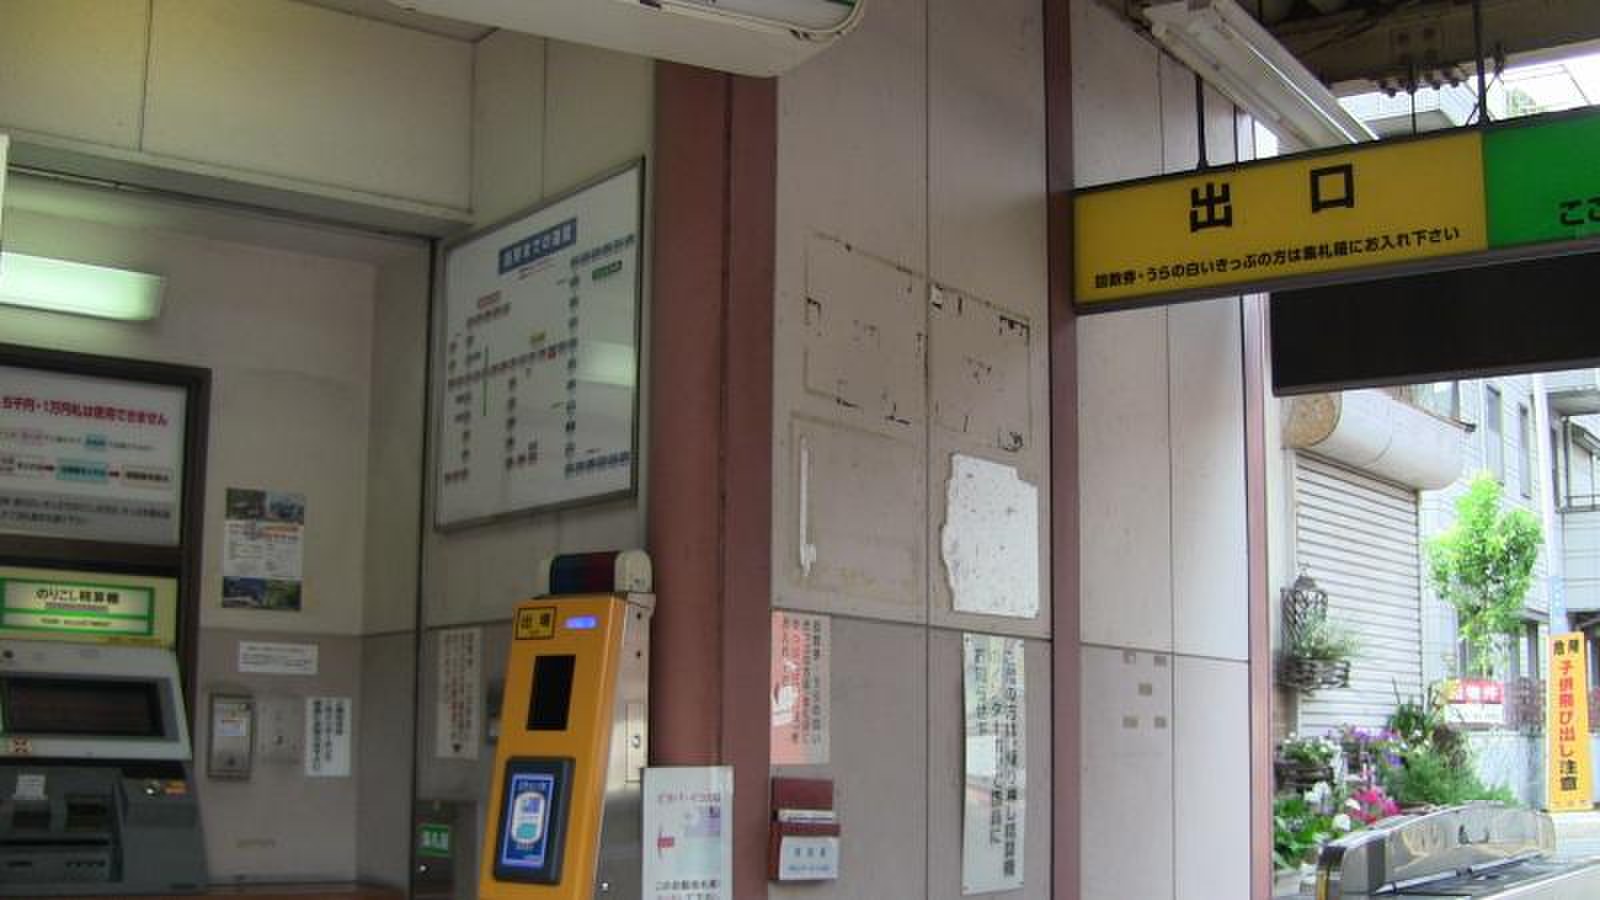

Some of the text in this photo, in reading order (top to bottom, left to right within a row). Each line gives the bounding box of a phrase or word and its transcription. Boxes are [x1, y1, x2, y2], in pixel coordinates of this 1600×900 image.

[1558, 660, 1578, 791] 子供飛び出し注意
